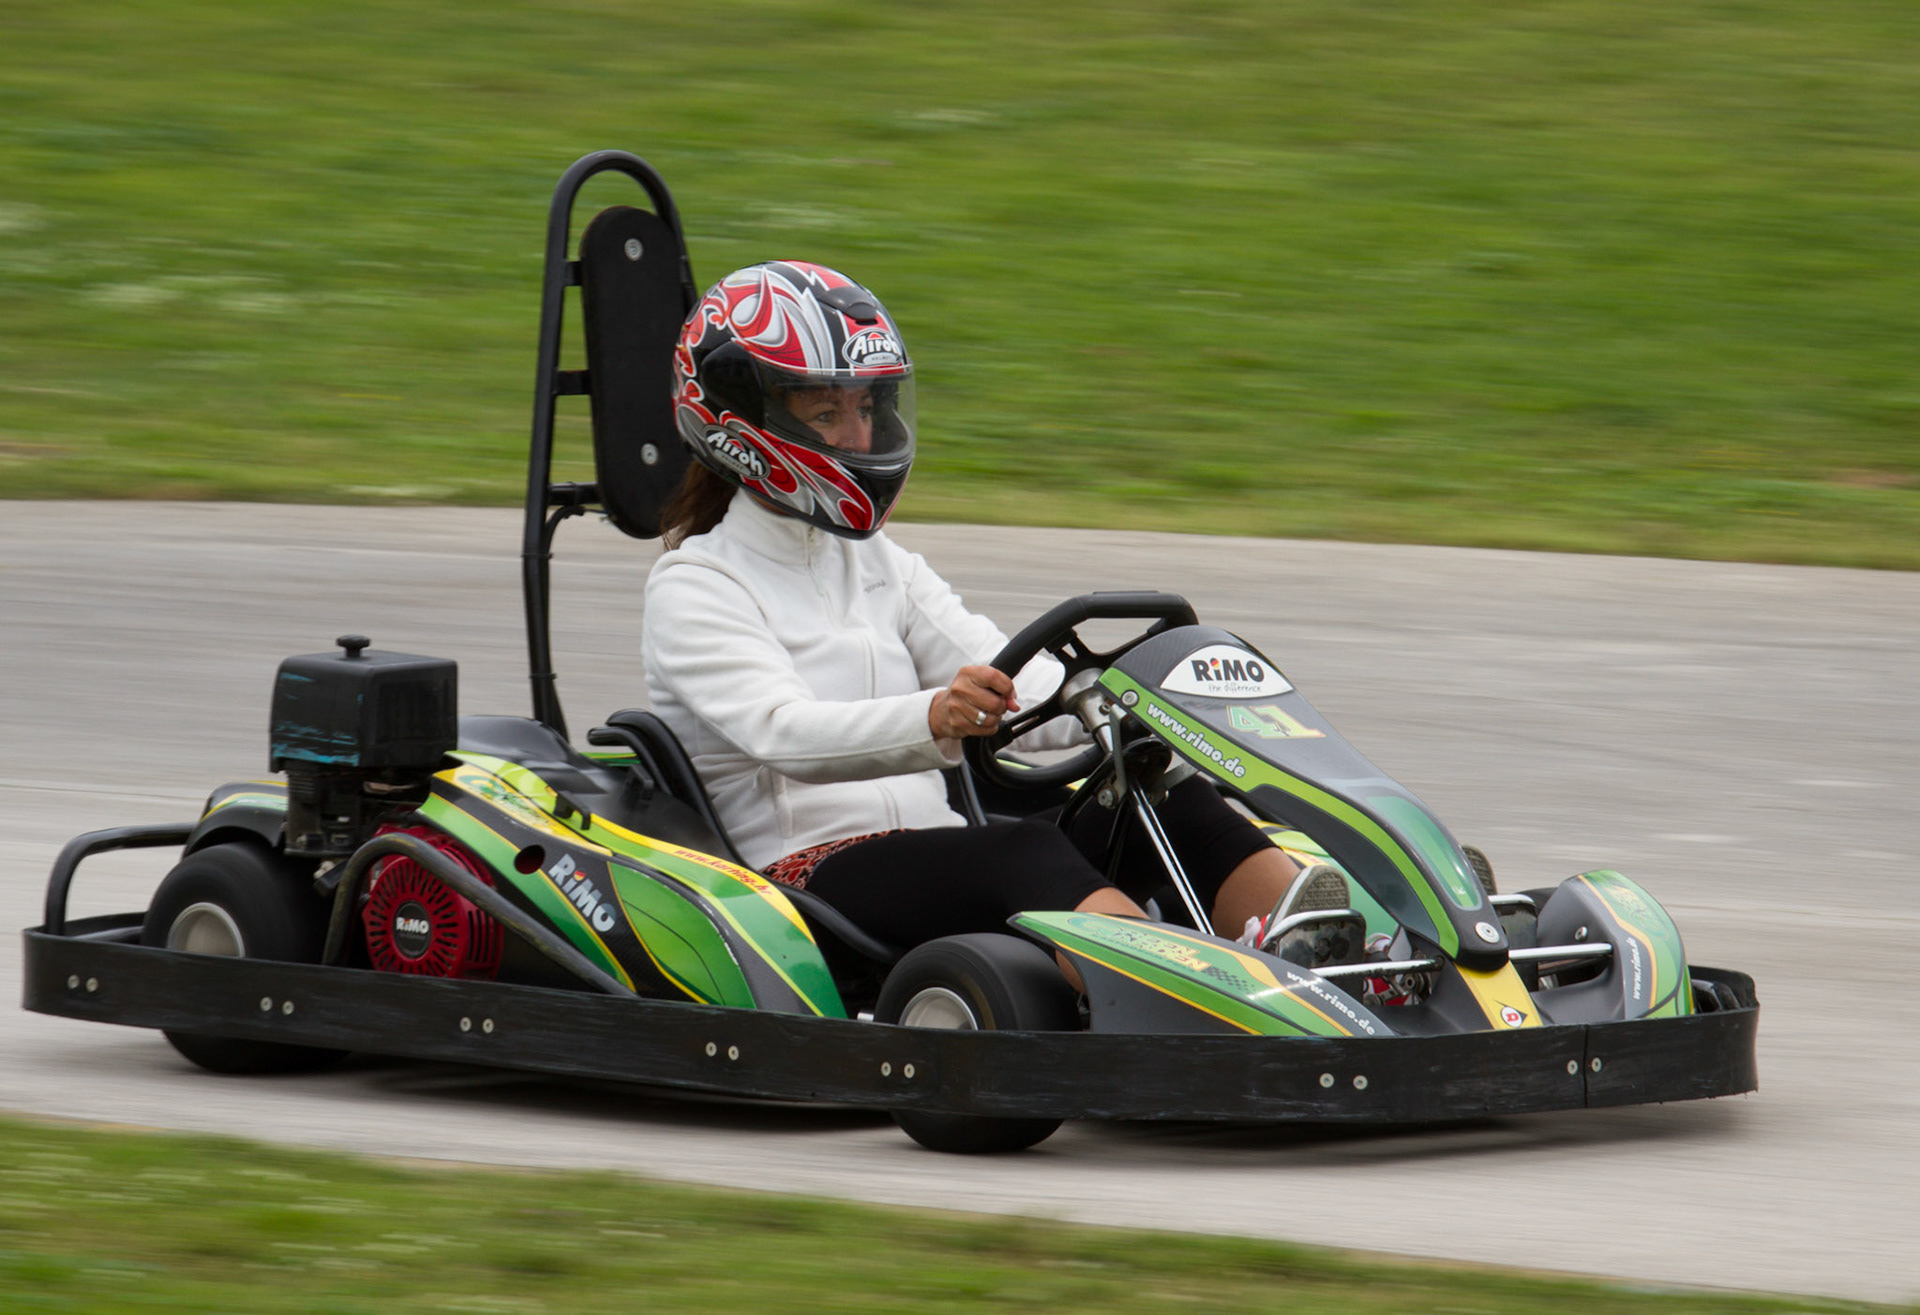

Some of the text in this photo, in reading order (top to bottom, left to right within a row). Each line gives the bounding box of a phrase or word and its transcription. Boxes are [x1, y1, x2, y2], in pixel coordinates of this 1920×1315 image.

[850, 333, 902, 361] Airoh
[706, 431, 764, 476] Airoh
[1224, 683, 1262, 693] difference
[1147, 702, 1246, 779] www.rimo.de
[1226, 703, 1326, 739] 41
[1286, 971, 1376, 1036] www.rimo.de
